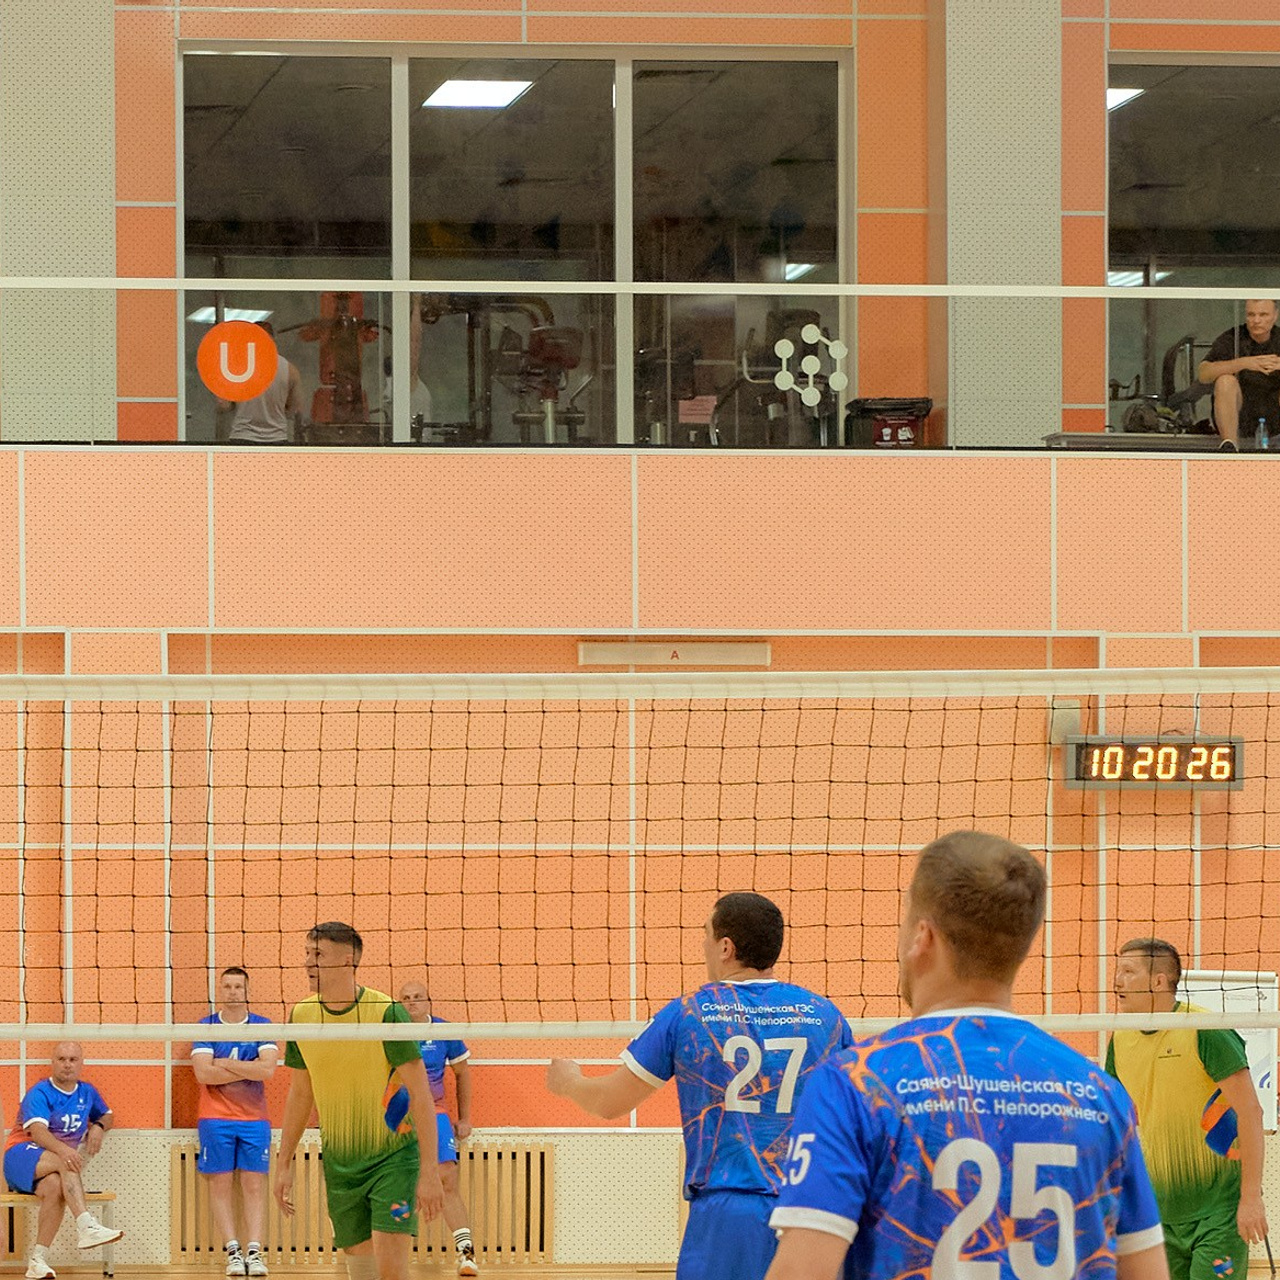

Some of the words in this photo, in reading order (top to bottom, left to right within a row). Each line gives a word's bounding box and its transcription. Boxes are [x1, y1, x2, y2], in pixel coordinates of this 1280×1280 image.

[220, 342, 255, 383] U
[1091, 746, 1124, 780] 10
[1132, 746, 1178, 780] 20
[1186, 746, 1231, 780] 26
[794, 1003, 815, 1014] ГЭС
[722, 1035, 808, 1114] 27
[896, 1073, 1064, 1095] Саяно-Шушенская
[1066, 1080, 1099, 1100] ГЭС
[61, 1113, 82, 1132] 15
[994, 1098, 1110, 1125] Непорожнего
